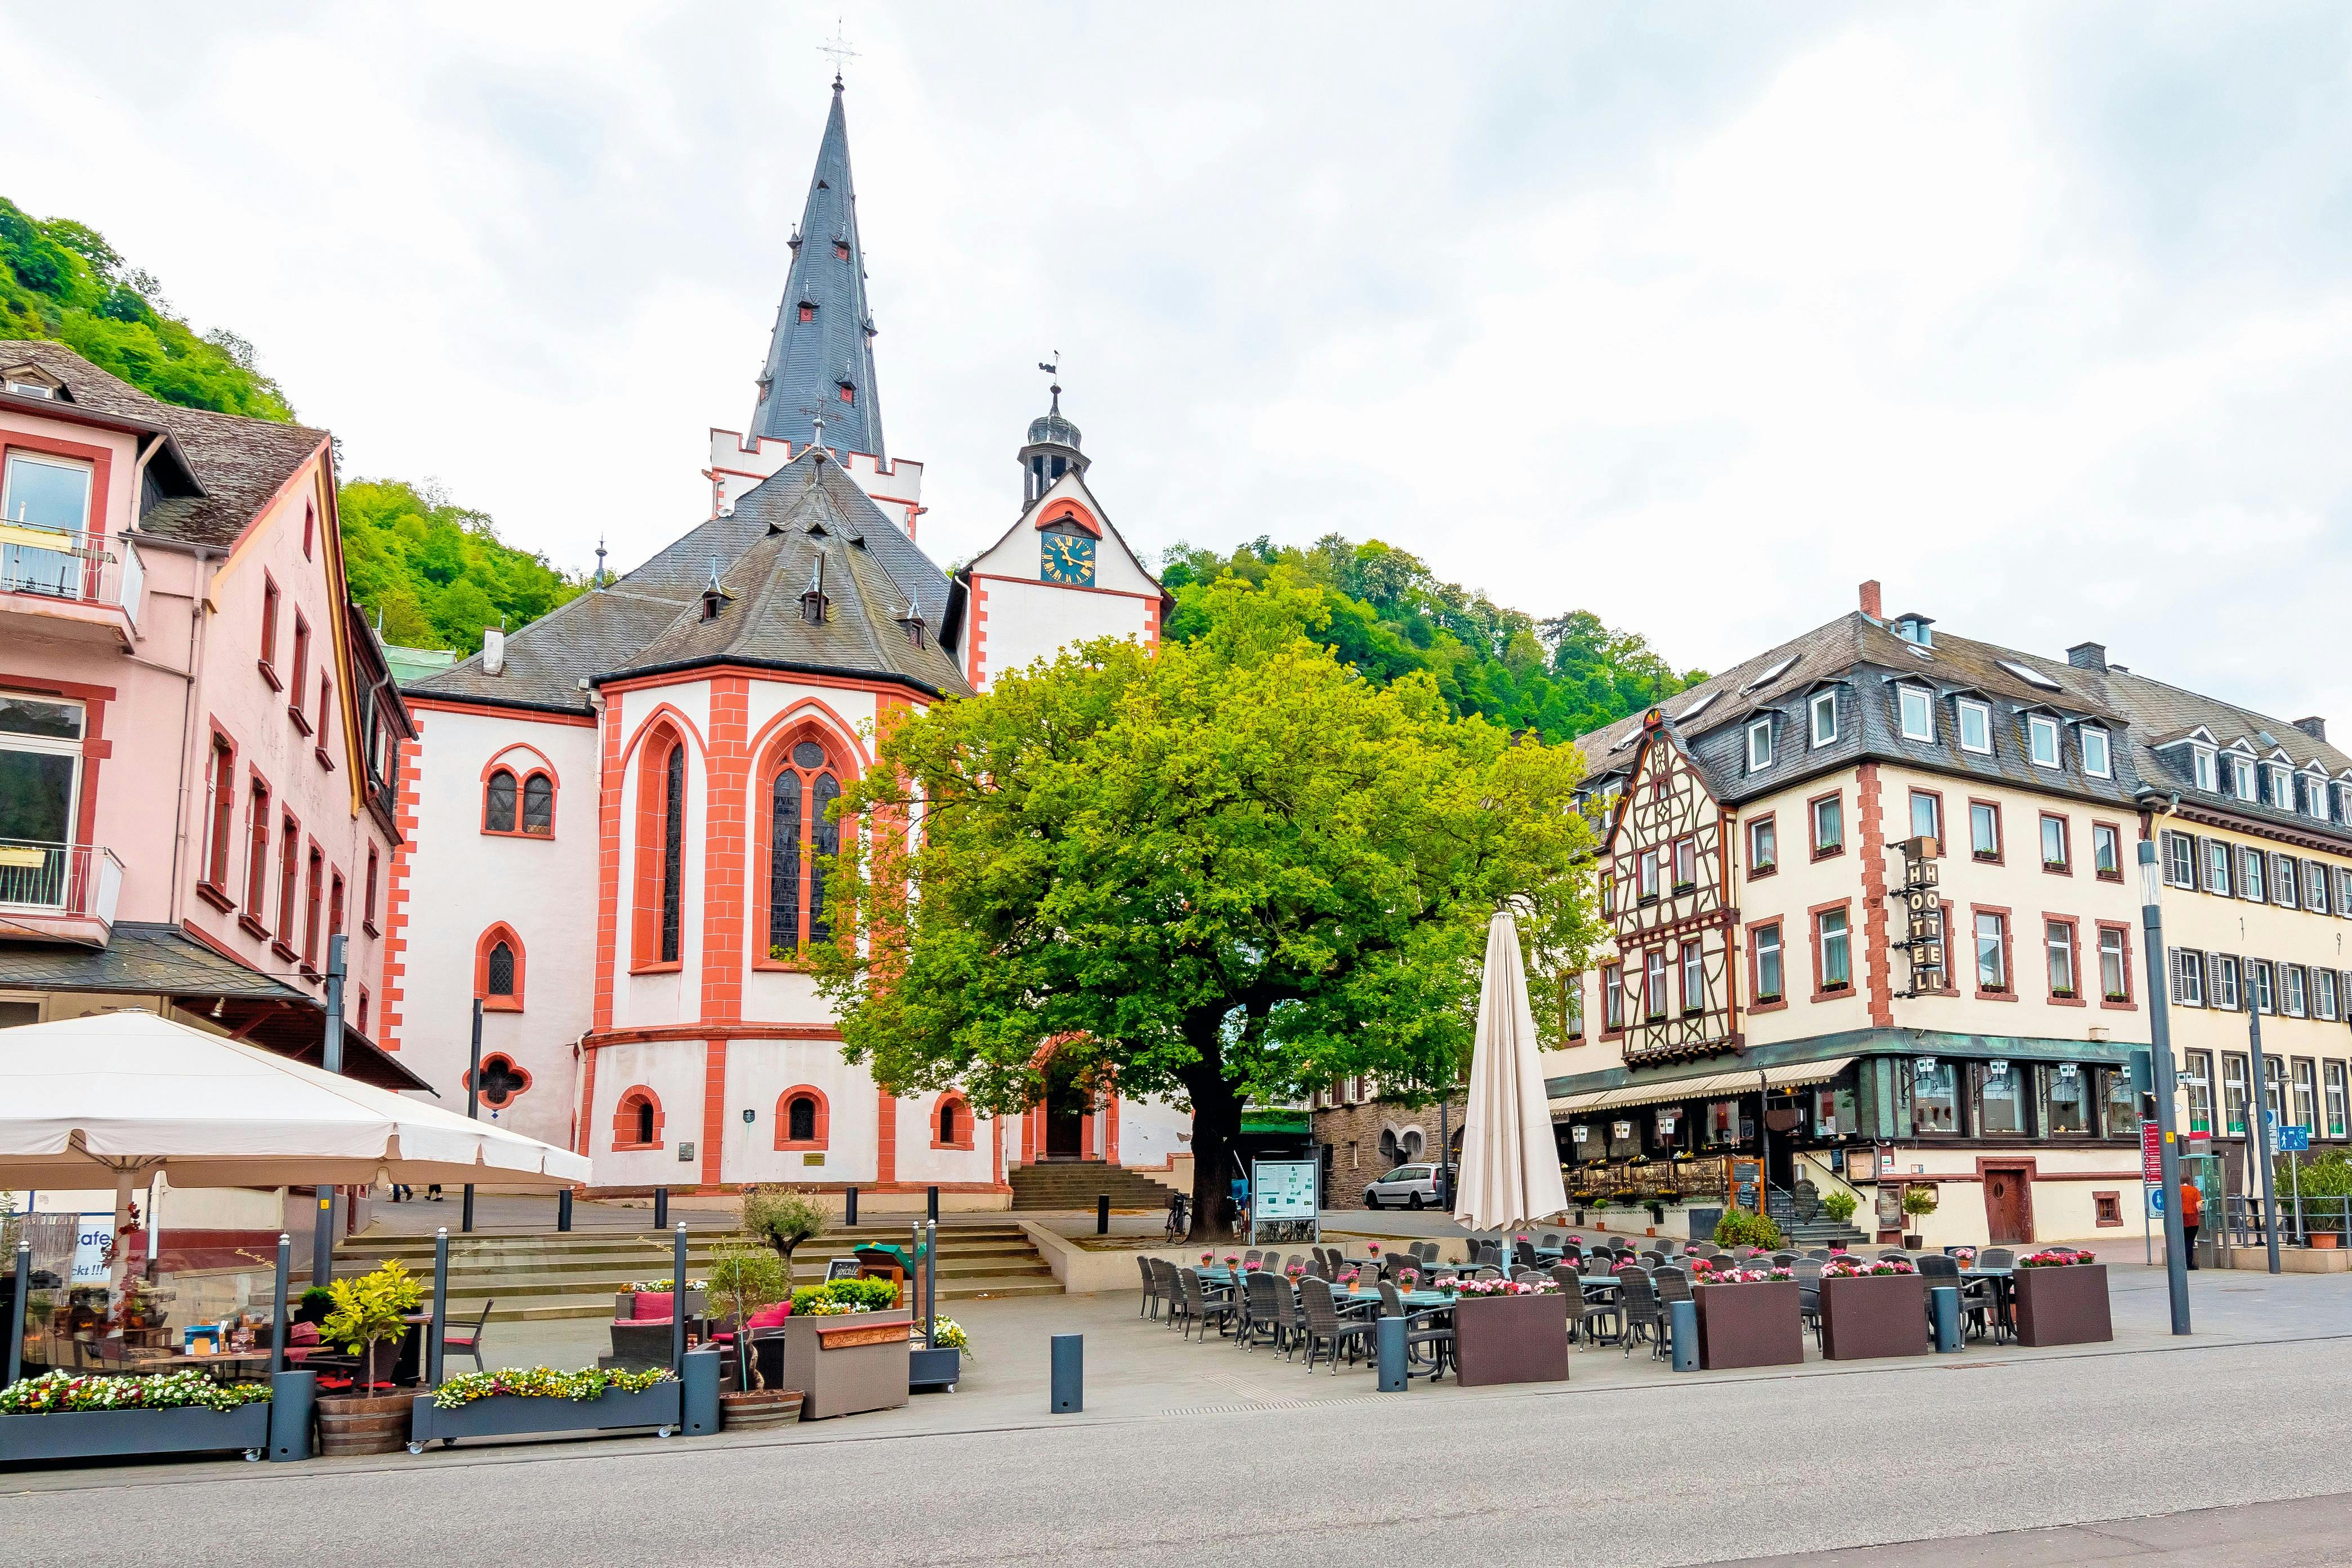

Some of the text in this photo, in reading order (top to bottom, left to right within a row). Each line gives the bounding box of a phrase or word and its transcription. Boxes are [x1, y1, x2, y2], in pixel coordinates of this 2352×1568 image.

[1910, 866, 1926, 991] HOTEL
[1925, 865, 1942, 990] HOTEL
[77, 1231, 110, 1245] afe
